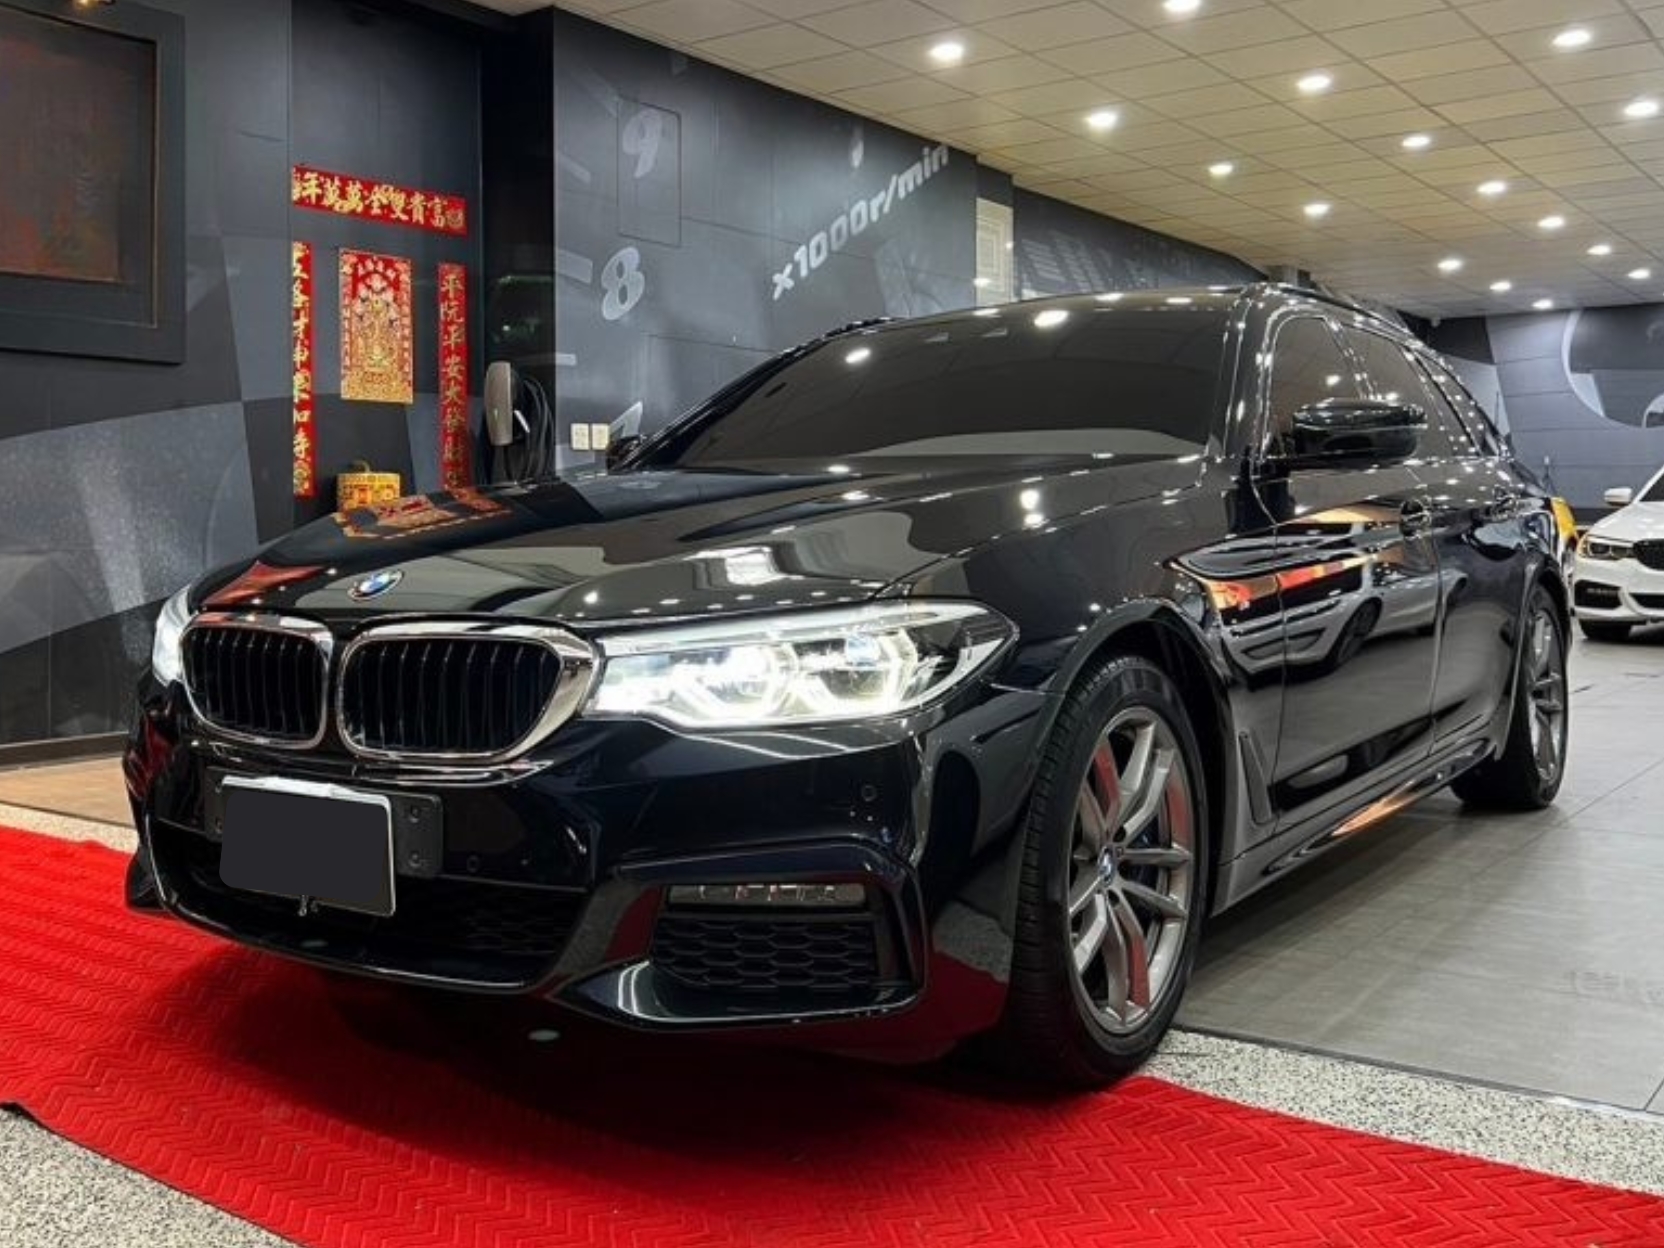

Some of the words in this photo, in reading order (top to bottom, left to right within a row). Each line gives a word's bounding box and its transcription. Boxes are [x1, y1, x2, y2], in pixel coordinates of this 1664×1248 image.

[623, 108, 662, 178] 9
[772, 145, 949, 300] x1000r/min
[601, 247, 645, 320] 8
